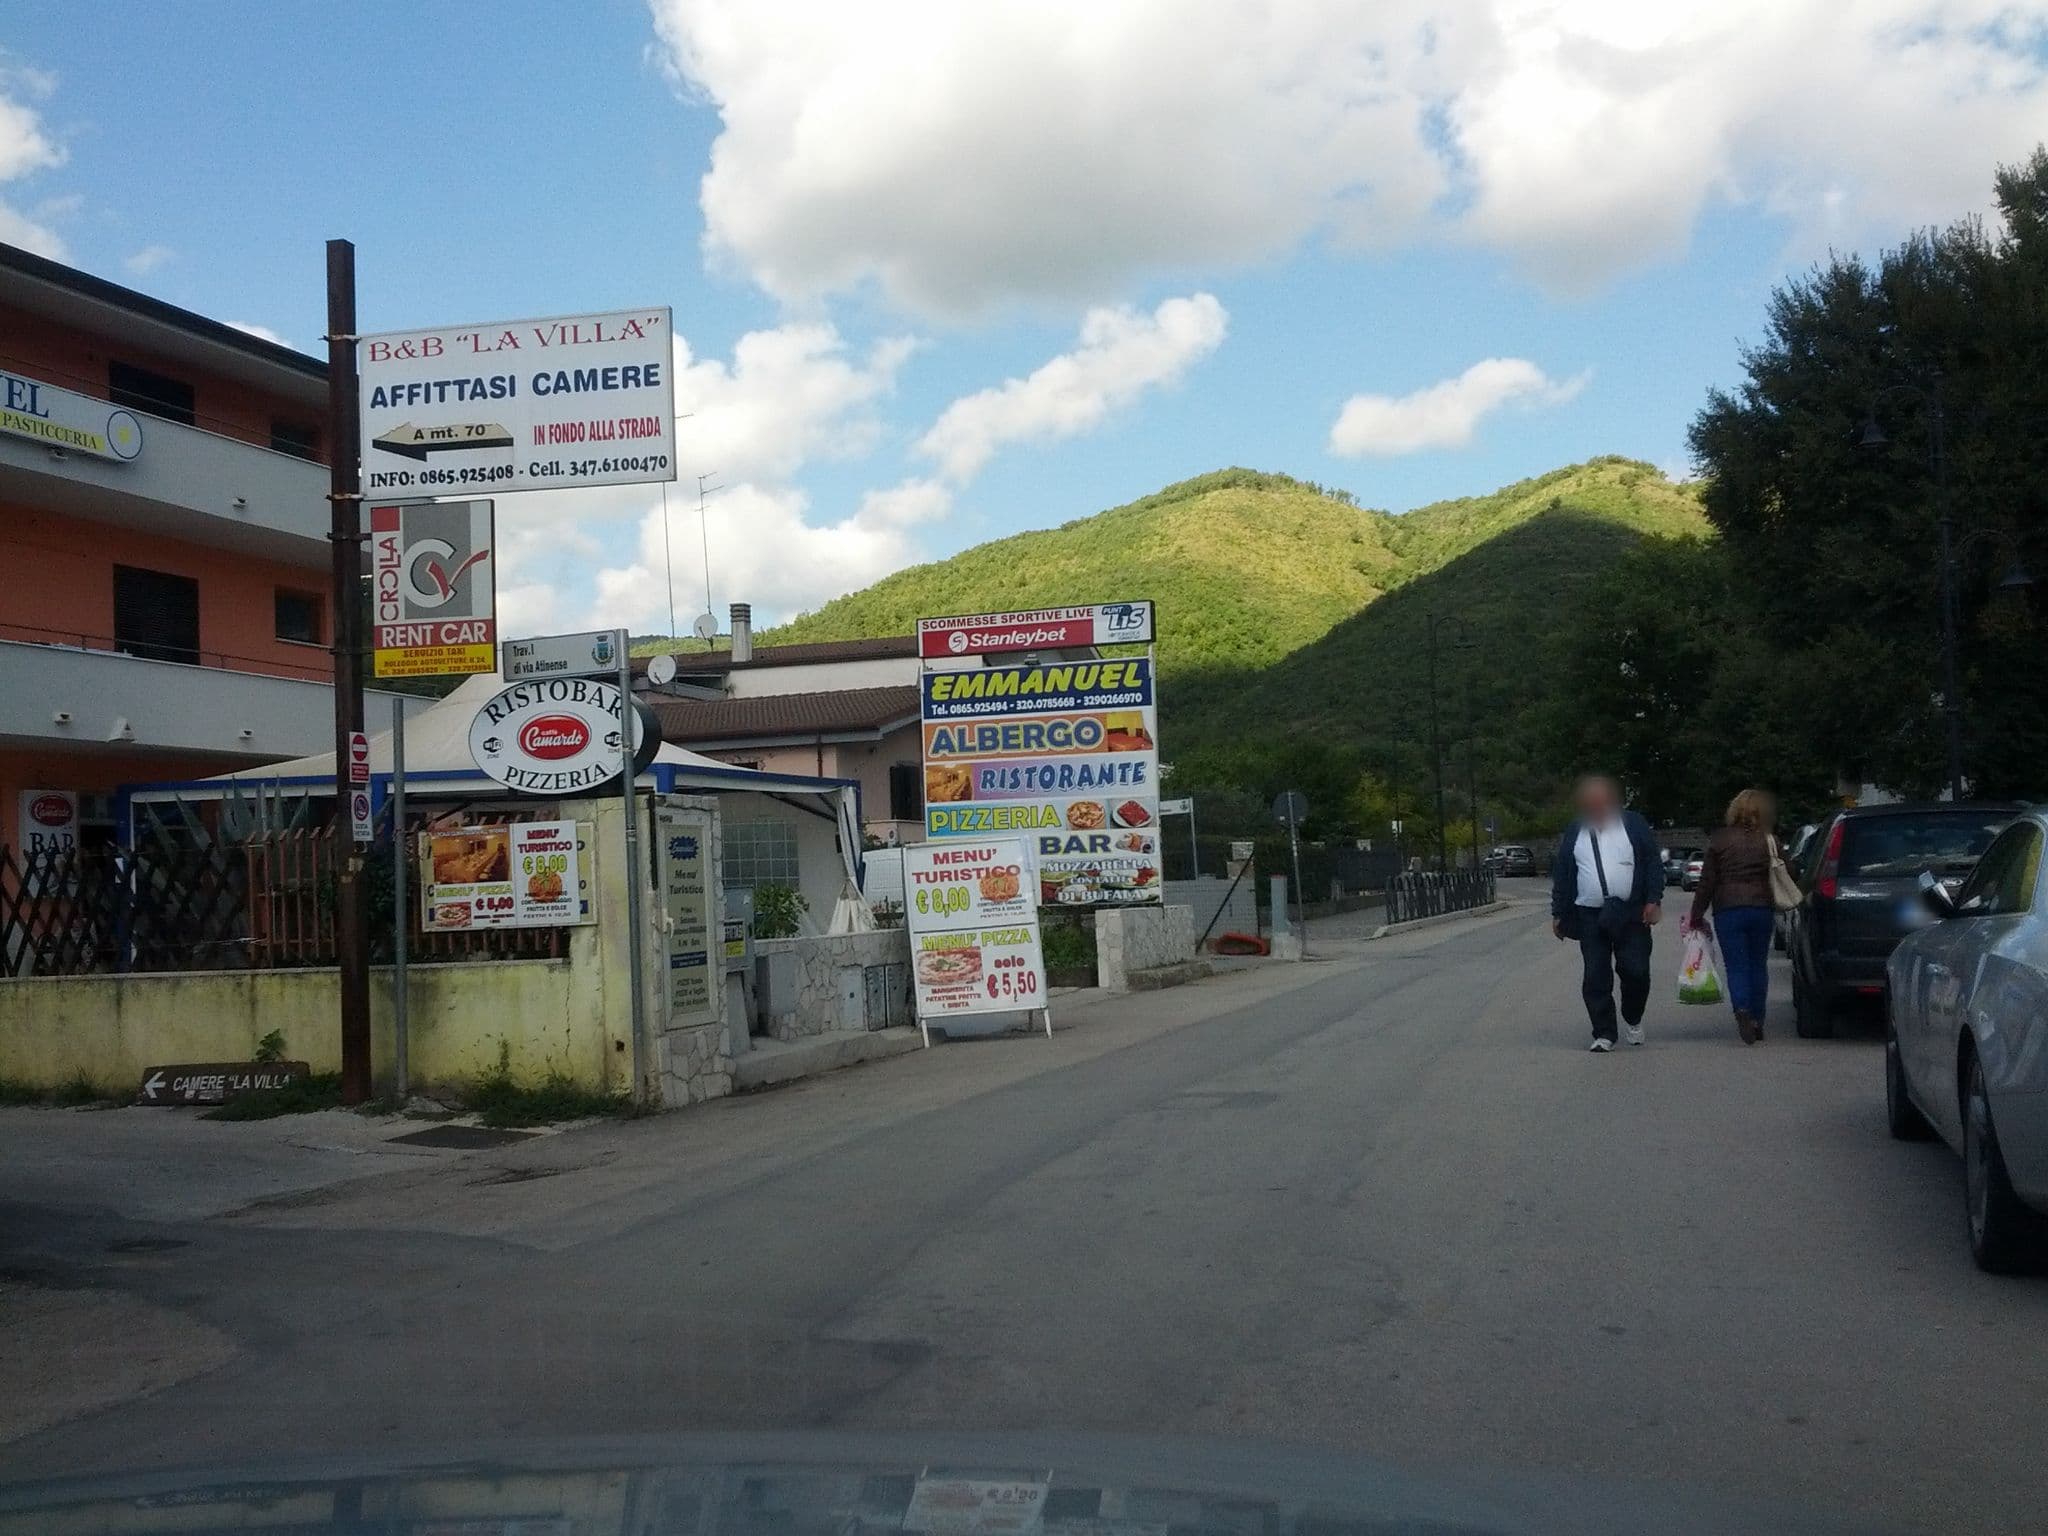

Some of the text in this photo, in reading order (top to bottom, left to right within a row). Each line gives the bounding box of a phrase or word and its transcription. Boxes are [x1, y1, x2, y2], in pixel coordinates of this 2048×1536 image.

[369, 316, 661, 362] B&B "LA VILLA"
[0, 374, 49, 418] EL
[370, 363, 660, 409] AFFITTASI CAMERE
[2, 412, 98, 450] PASTICCERIA
[413, 423, 486, 441] A mt. 70
[534, 416, 661, 446] IN FONDO ALLA STRADA
[370, 471, 415, 488] INFO:
[419, 465, 514, 485] 0865.925408
[529, 462, 564, 478] Cell.
[569, 455, 668, 475] 347.6100470
[922, 607, 1094, 631] SCOMMESSE SPORTIVE LIVE
[382, 622, 487, 648] RENT CAR
[970, 627, 1067, 648] Stanleybet
[403, 649, 444, 659] SERVIZIO
[513, 659, 568, 674] di via Atinense
[932, 663, 1143, 701] EMMANUEL
[483, 679, 623, 726] RISTOBAR
[932, 704, 948, 716] Tel.
[950, 701, 1008, 714] 0865.925494
[929, 718, 1104, 758] ALBERGO
[504, 763, 609, 790] PIZZERIA
[980, 761, 1146, 792] RISTORANTE
[930, 804, 1062, 833] PIZZERIA
[517, 842, 573, 854] TURISTICO
[1039, 834, 1112, 855] BAR
[933, 848, 997, 865] MENU'
[1046, 858, 1151, 873] MOZZARELLA
[912, 865, 1021, 884] TURISTICO
[1070, 876, 1092, 885] CON
[669, 884, 704, 896] Turistico
[916, 886, 971, 917] € 8,00
[1057, 889, 1143, 902] DI BUFALA
[922, 928, 1032, 950] MENU' PIZZA
[994, 955, 1025, 968] solo
[986, 970, 1036, 1002] € 5,50
[173, 1075, 225, 1091] CAMERE
